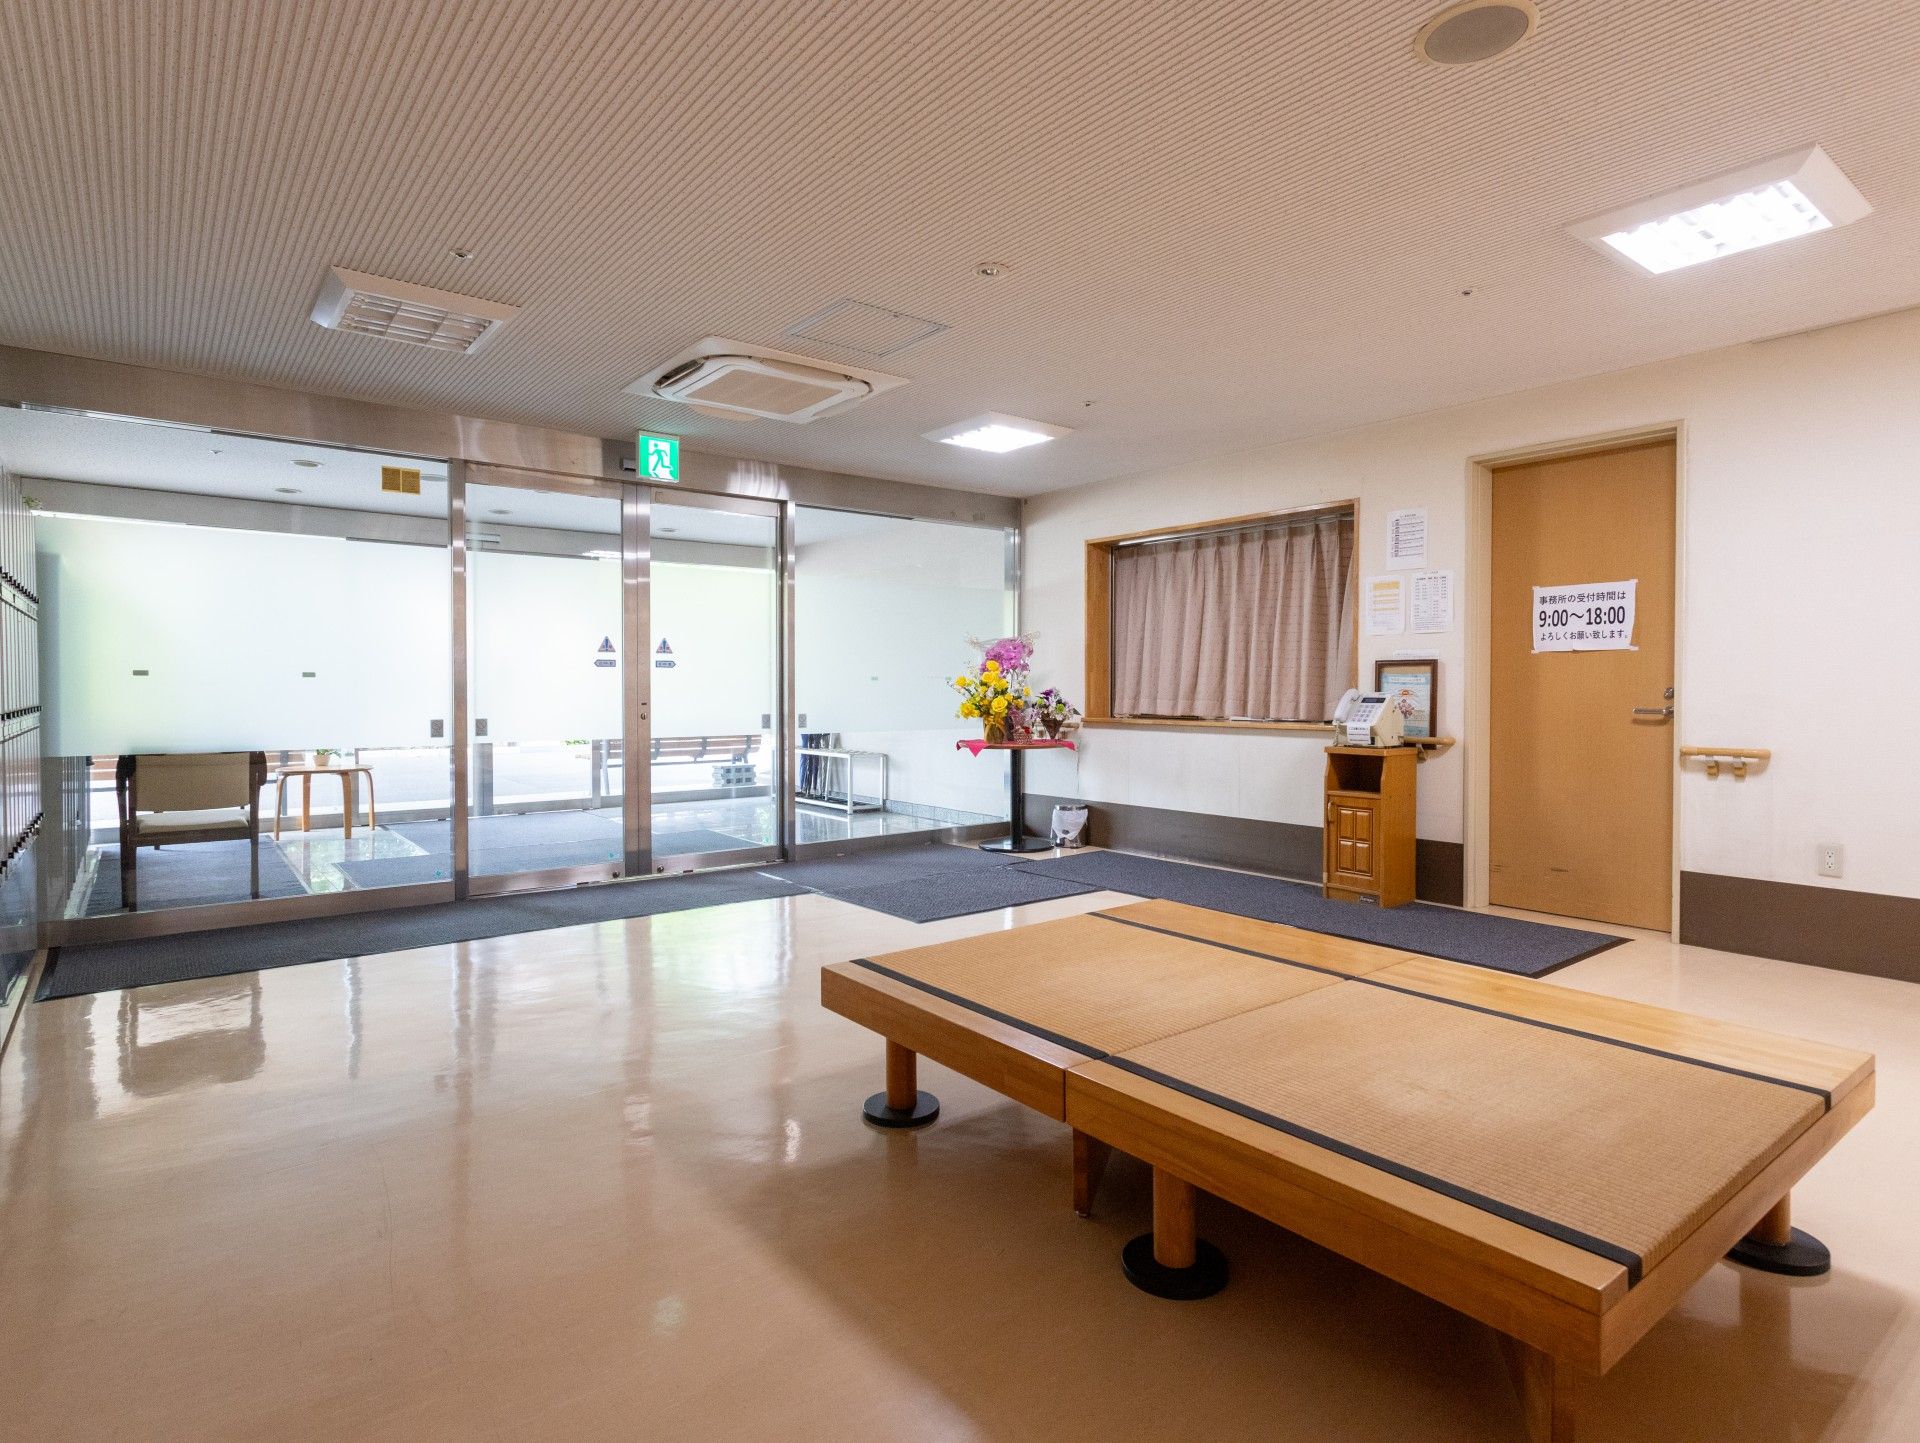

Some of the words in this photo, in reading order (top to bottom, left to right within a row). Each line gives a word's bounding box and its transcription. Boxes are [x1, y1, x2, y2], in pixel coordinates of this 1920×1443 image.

[1539, 590, 1627, 605] 事務所の受付時間は
[1540, 629, 1628, 642] よろしくお願い致します。
